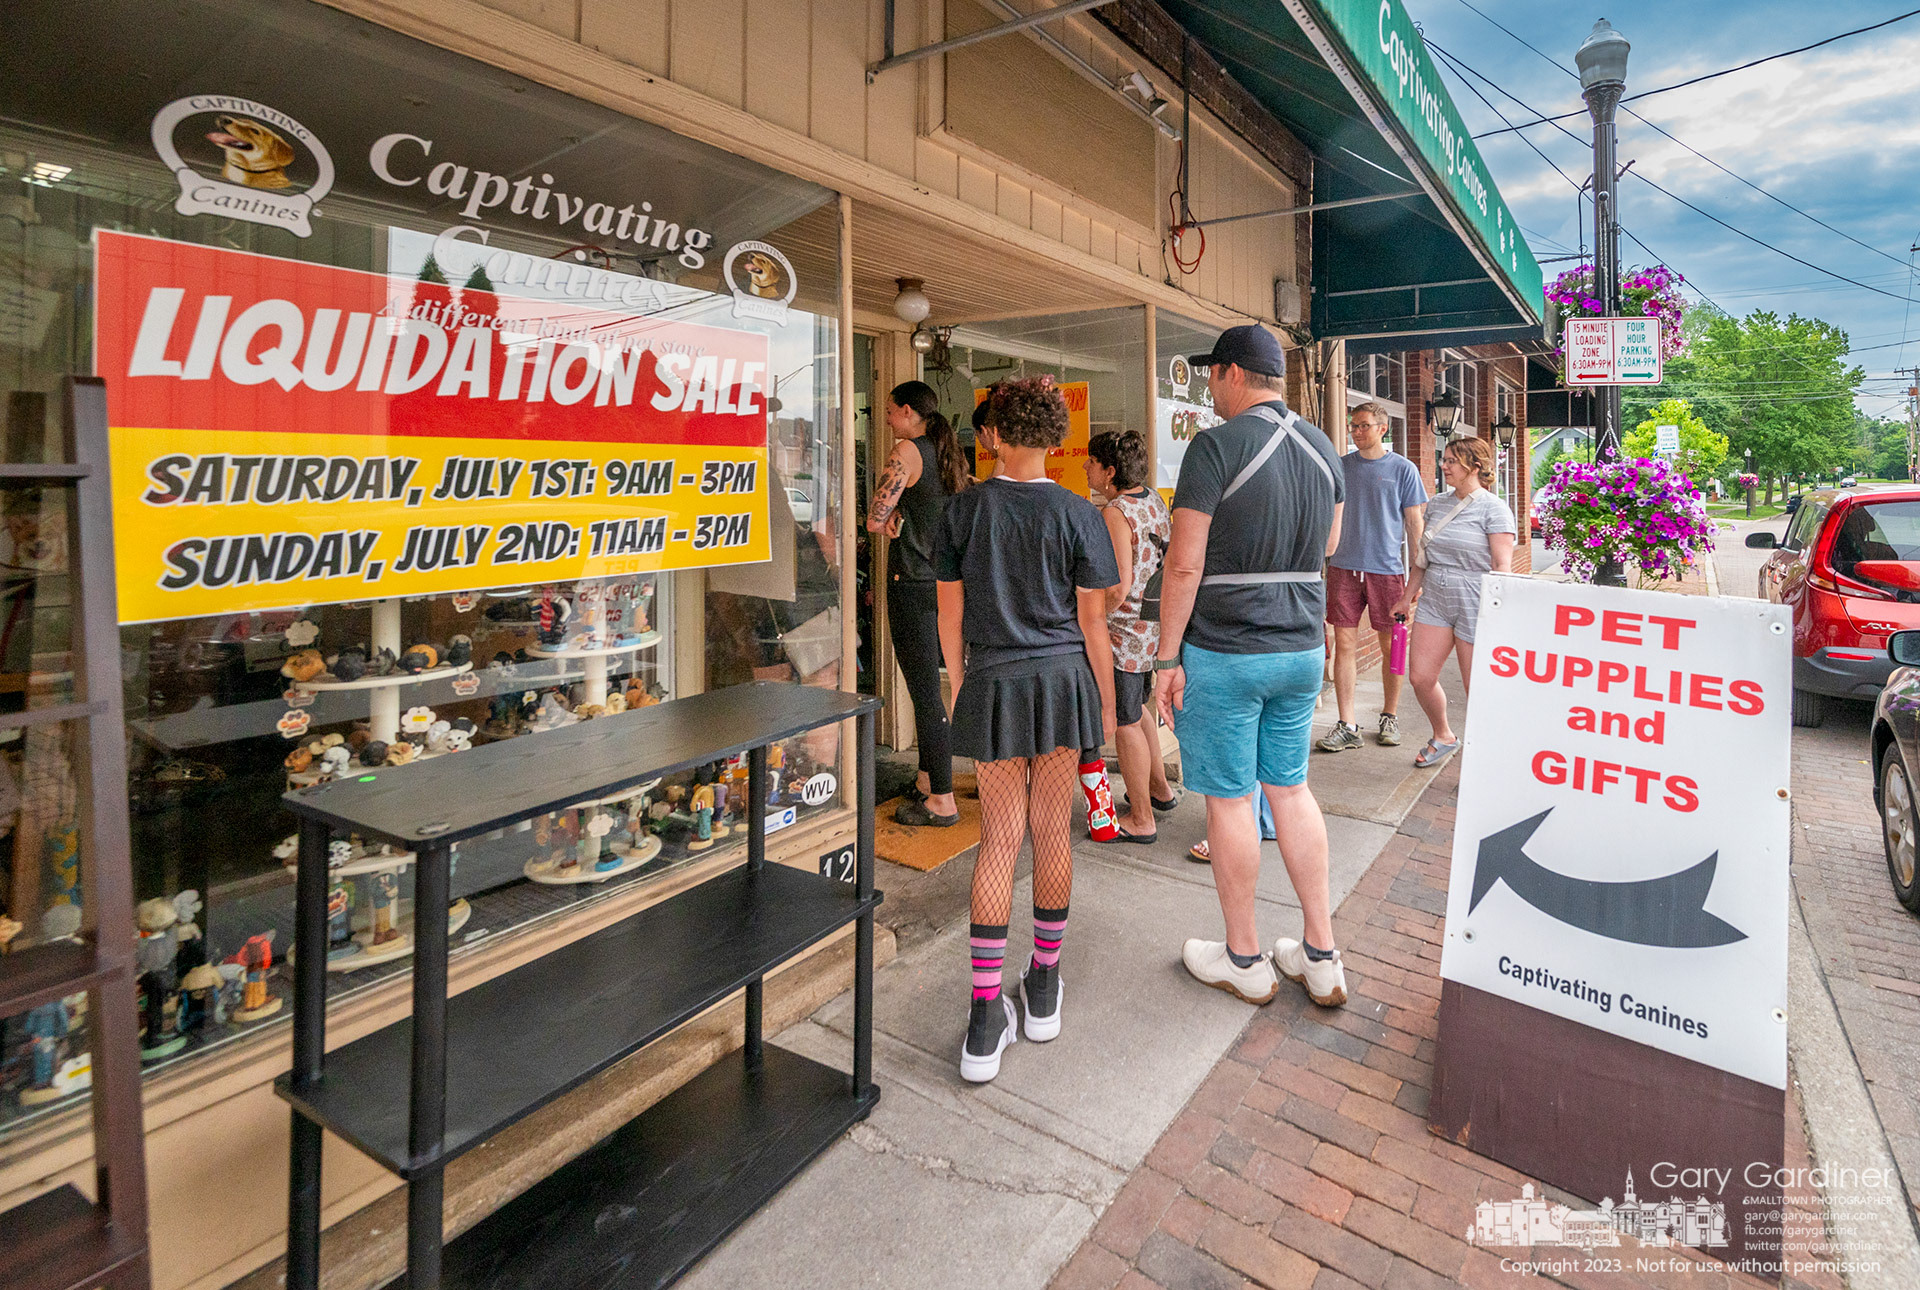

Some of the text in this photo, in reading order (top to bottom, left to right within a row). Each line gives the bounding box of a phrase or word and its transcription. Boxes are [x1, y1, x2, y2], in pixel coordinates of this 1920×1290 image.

[190, 97, 310, 141] CAPTIVATING
[1378, 0, 1488, 217] Captivating Canines
[191, 186, 301, 221] Canines
[369, 133, 712, 269] Captivating
[432, 225, 671, 310] Canines
[738, 242, 787, 264] CAPTIVATING
[739, 300, 784, 317] Canines
[1626, 322, 1645, 332] FOUR
[410, 299, 530, 333] different
[537, 317, 592, 341] kind
[596, 329, 622, 351] of
[623, 335, 654, 354] pet
[660, 340, 706, 357] store
[1573, 323, 1608, 333] 15 MINUTE
[1575, 335, 1607, 345] LOADING
[1626, 334, 1646, 343] HOUR
[127, 287, 642, 407] LIQUIDATION
[650, 352, 766, 416] SALE
[1572, 359, 1612, 369] 6:30AM-9PM
[1582, 348, 1600, 357] ZONE
[1617, 357, 1656, 367] 6:30AM-9PM
[1621, 346, 1653, 355] PARKING
[144, 454, 757, 507] SATURDAY, JULY 1ST: 9AM - 3PM
[158, 513, 751, 591] SUNDAY, JULY 2ND: 11AM - 3PM
[1553, 604, 1697, 651] PET
[1489, 646, 1765, 717] SUPPLIES
[1566, 706, 1666, 746] and
[805, 780, 833, 800] WVL
[1531, 750, 1700, 814] GIFTS
[823, 850, 854, 883] 12
[1498, 955, 1709, 1040] Captivating Canines
